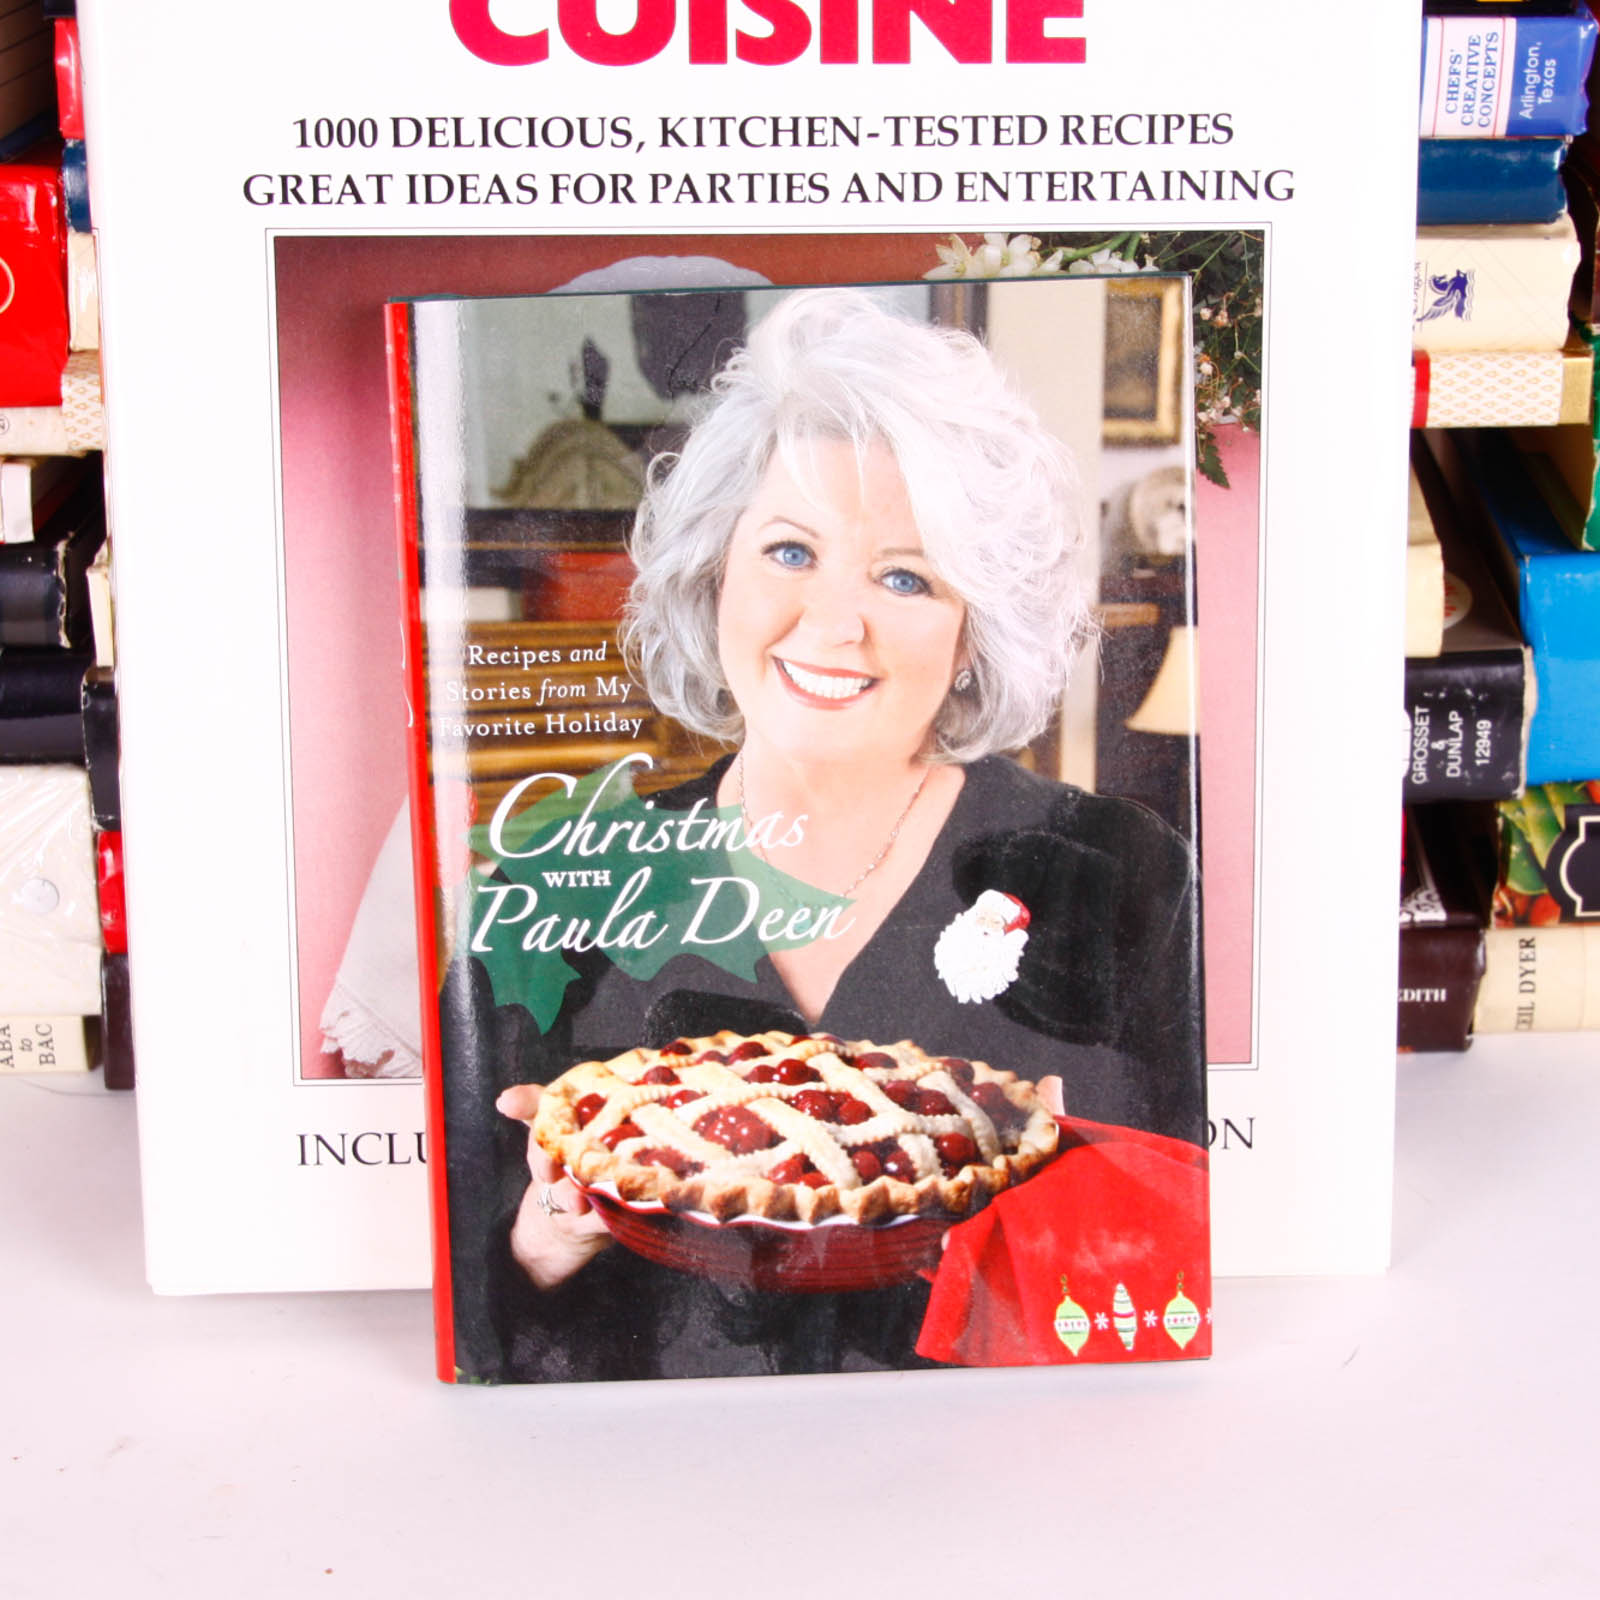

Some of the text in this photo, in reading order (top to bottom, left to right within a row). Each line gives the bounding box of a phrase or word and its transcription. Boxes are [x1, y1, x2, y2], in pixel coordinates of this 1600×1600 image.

[448, 0, 1087, 67] CUISINE
[1445, 49, 1462, 114] CHEFS'
[1461, 34, 1481, 126] CREATIVE
[1478, 31, 1499, 128] CONCEPTS
[1519, 42, 1542, 119] Arlington,
[1538, 59, 1557, 104] Texas
[293, 112, 1234, 153] 1000 DELICIOUS, KITCHEN-TESTED RECIPES
[243, 169, 1294, 206] GREAT IDEAS FOR PARTIES AND ENTERTAINING
[468, 641, 606, 670] Recipes and
[446, 676, 632, 706] Stories from My
[438, 712, 643, 738] Favorite Holiday
[1412, 706, 1430, 784] GROSSET
[1431, 740, 1445, 750] &
[1446, 711, 1463, 778] DUNLAP
[1475, 720, 1492, 766] 12949
[489, 752, 809, 859] Christmas
[542, 870, 611, 888] WITH
[470, 866, 857, 953] Paula Deen
[1519, 937, 1536, 994] DYER
[35, 1023, 56, 1067] BAC
